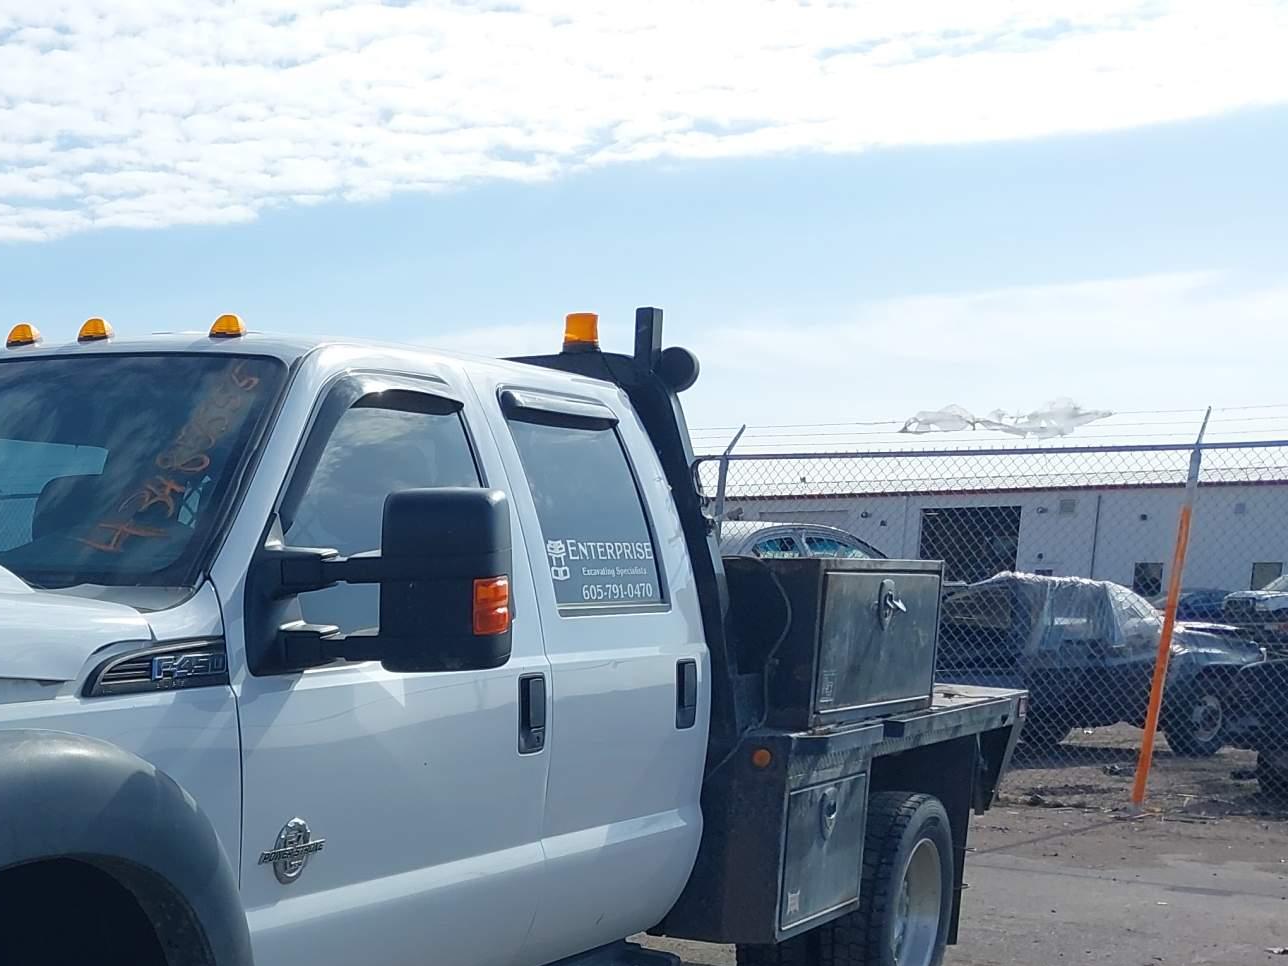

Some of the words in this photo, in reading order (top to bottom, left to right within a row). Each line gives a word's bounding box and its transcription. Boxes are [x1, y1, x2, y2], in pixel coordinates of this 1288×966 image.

[567, 540, 653, 560] ENTERPRISE
[582, 567, 615, 577] Excavating
[582, 582, 653, 600] 605-791-0470
